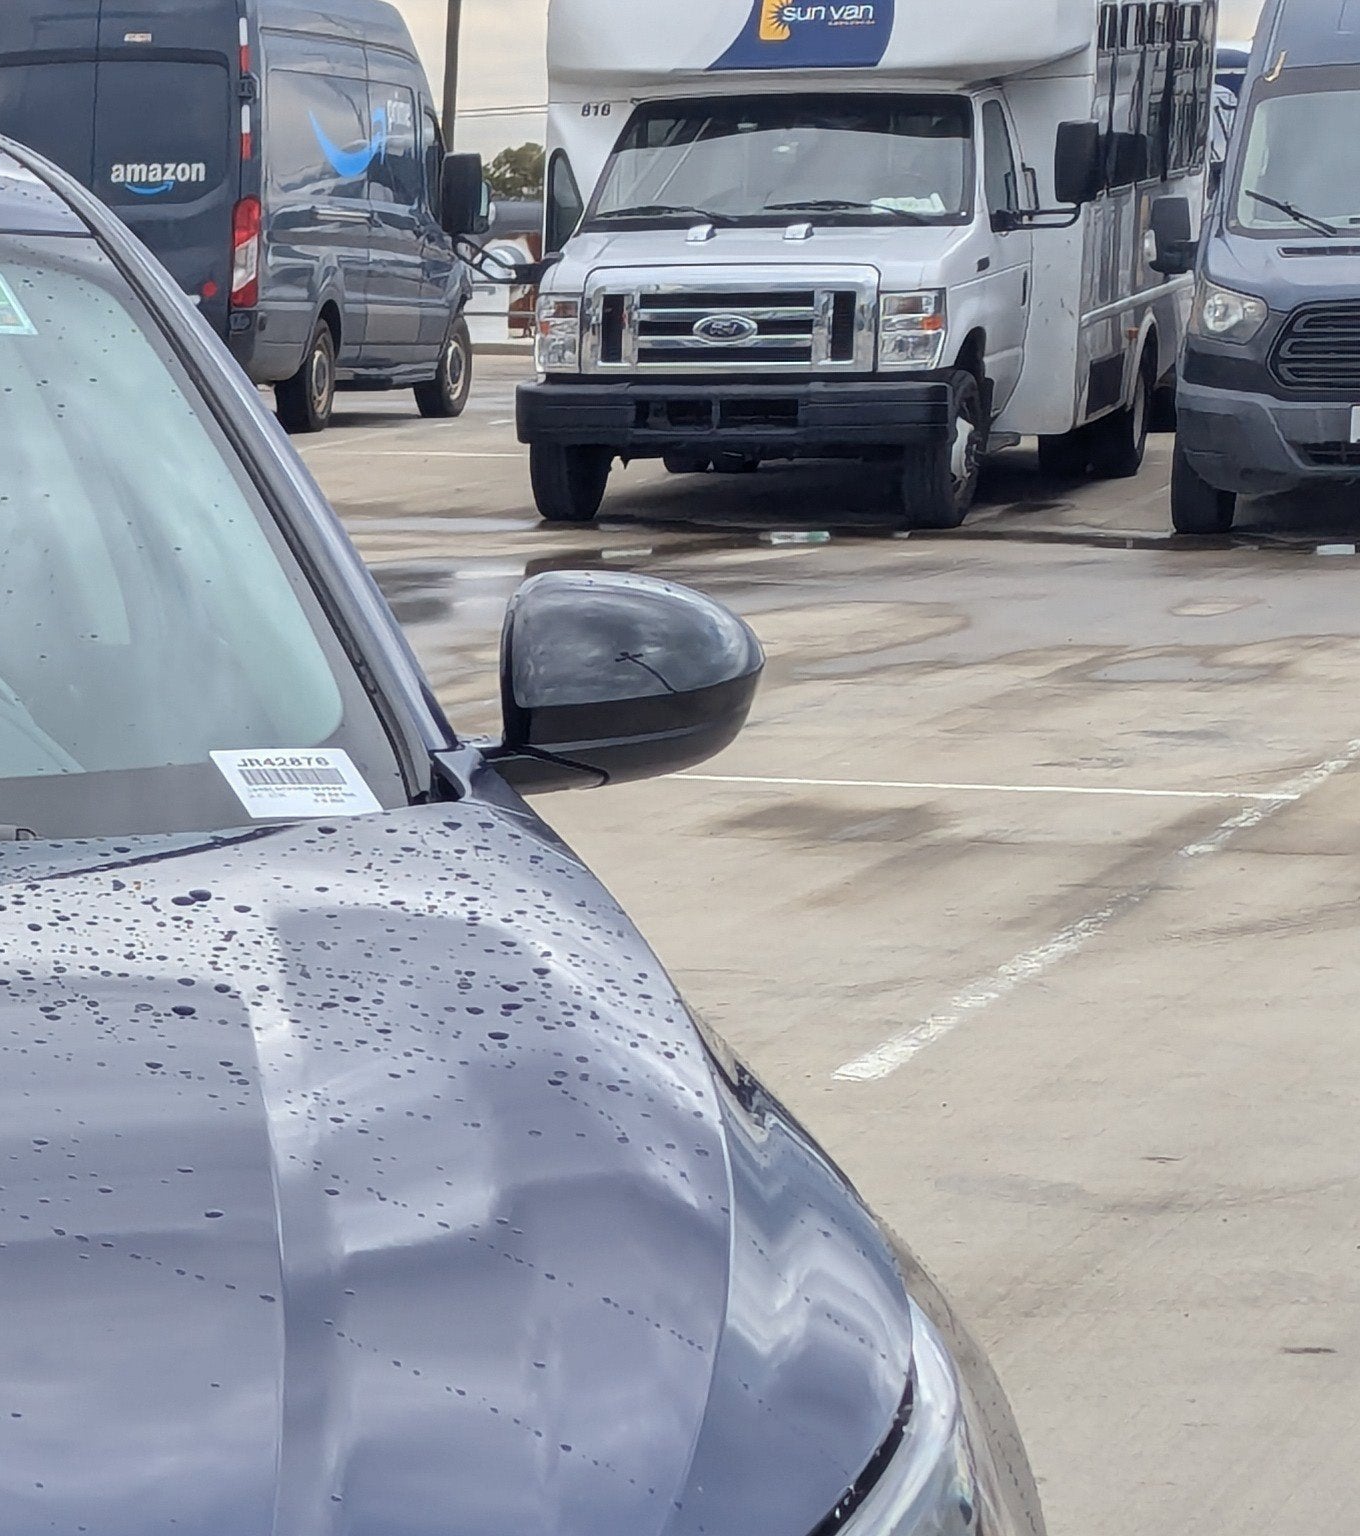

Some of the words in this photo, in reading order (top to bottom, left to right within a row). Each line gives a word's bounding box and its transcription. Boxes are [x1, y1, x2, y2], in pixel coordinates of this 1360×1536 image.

[782, 5, 825, 21] sun
[830, 4, 873, 20] van
[110, 161, 206, 184] amazon
